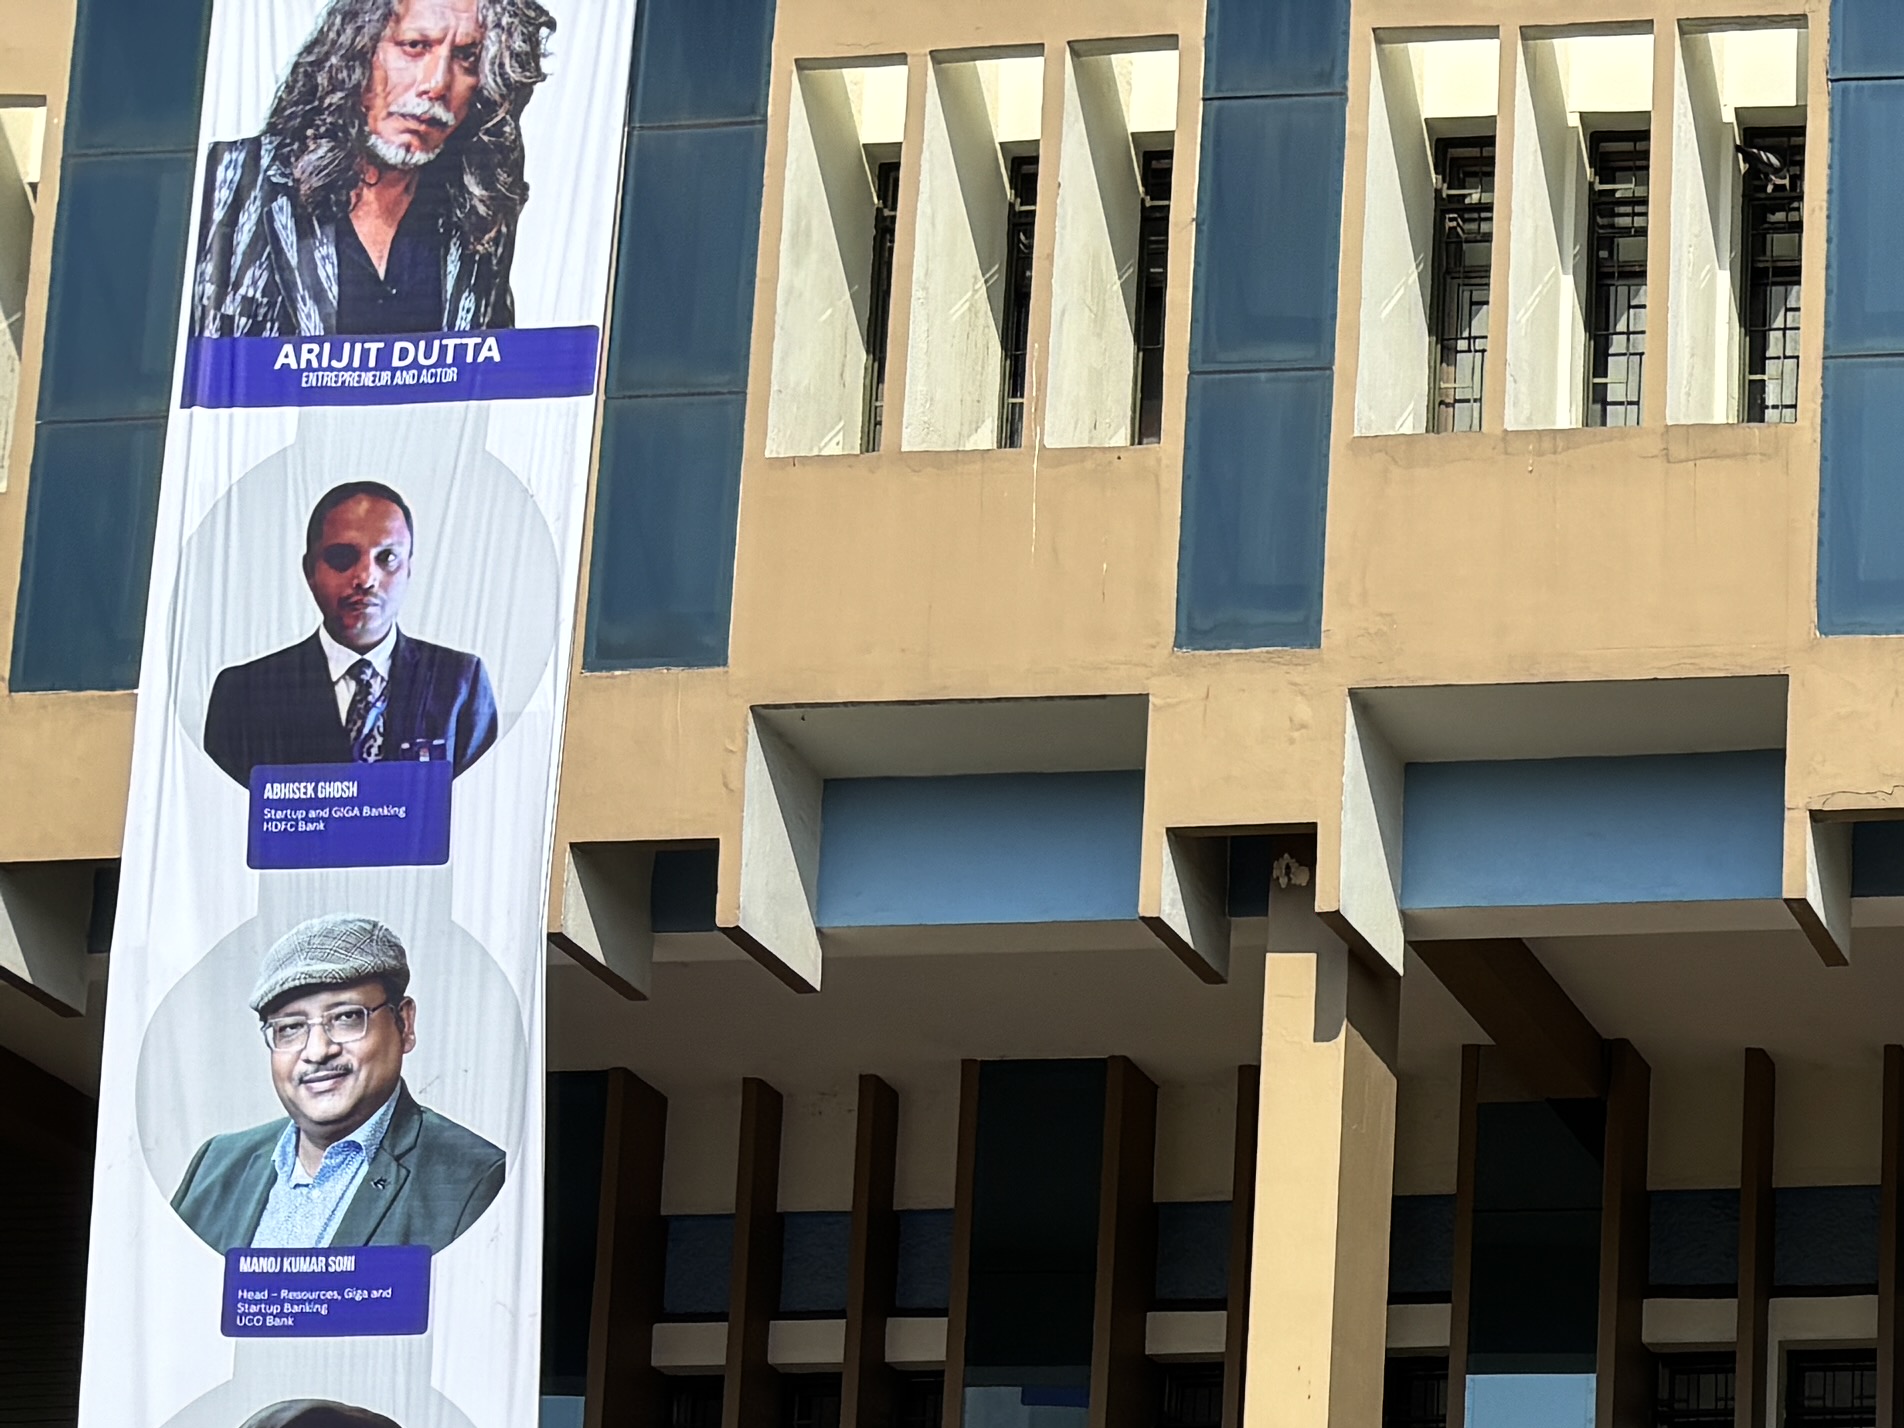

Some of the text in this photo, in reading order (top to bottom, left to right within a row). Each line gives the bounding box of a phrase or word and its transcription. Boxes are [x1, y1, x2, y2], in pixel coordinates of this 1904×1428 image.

[273, 336, 501, 370] ARIJIT DUTTA
[301, 367, 457, 388] ENTREPRENEUR AND ACTOR
[263, 780, 358, 799] ABHISEK GHOSH
[263, 808, 306, 821] Startup
[308, 807, 329, 819] and
[362, 804, 406, 819] Banking
[263, 820, 325, 832] HDFC Bank
[239, 1254, 356, 1273] MANOJ KUMAR SONI
[238, 1288, 268, 1300] Head
[280, 1288, 342, 1301] Resources,
[344, 1287, 368, 1301] Giga
[370, 1286, 392, 1299] and
[236, 1301, 328, 1316] Startup Banking
[236, 1314, 294, 1326] UCO Bank
